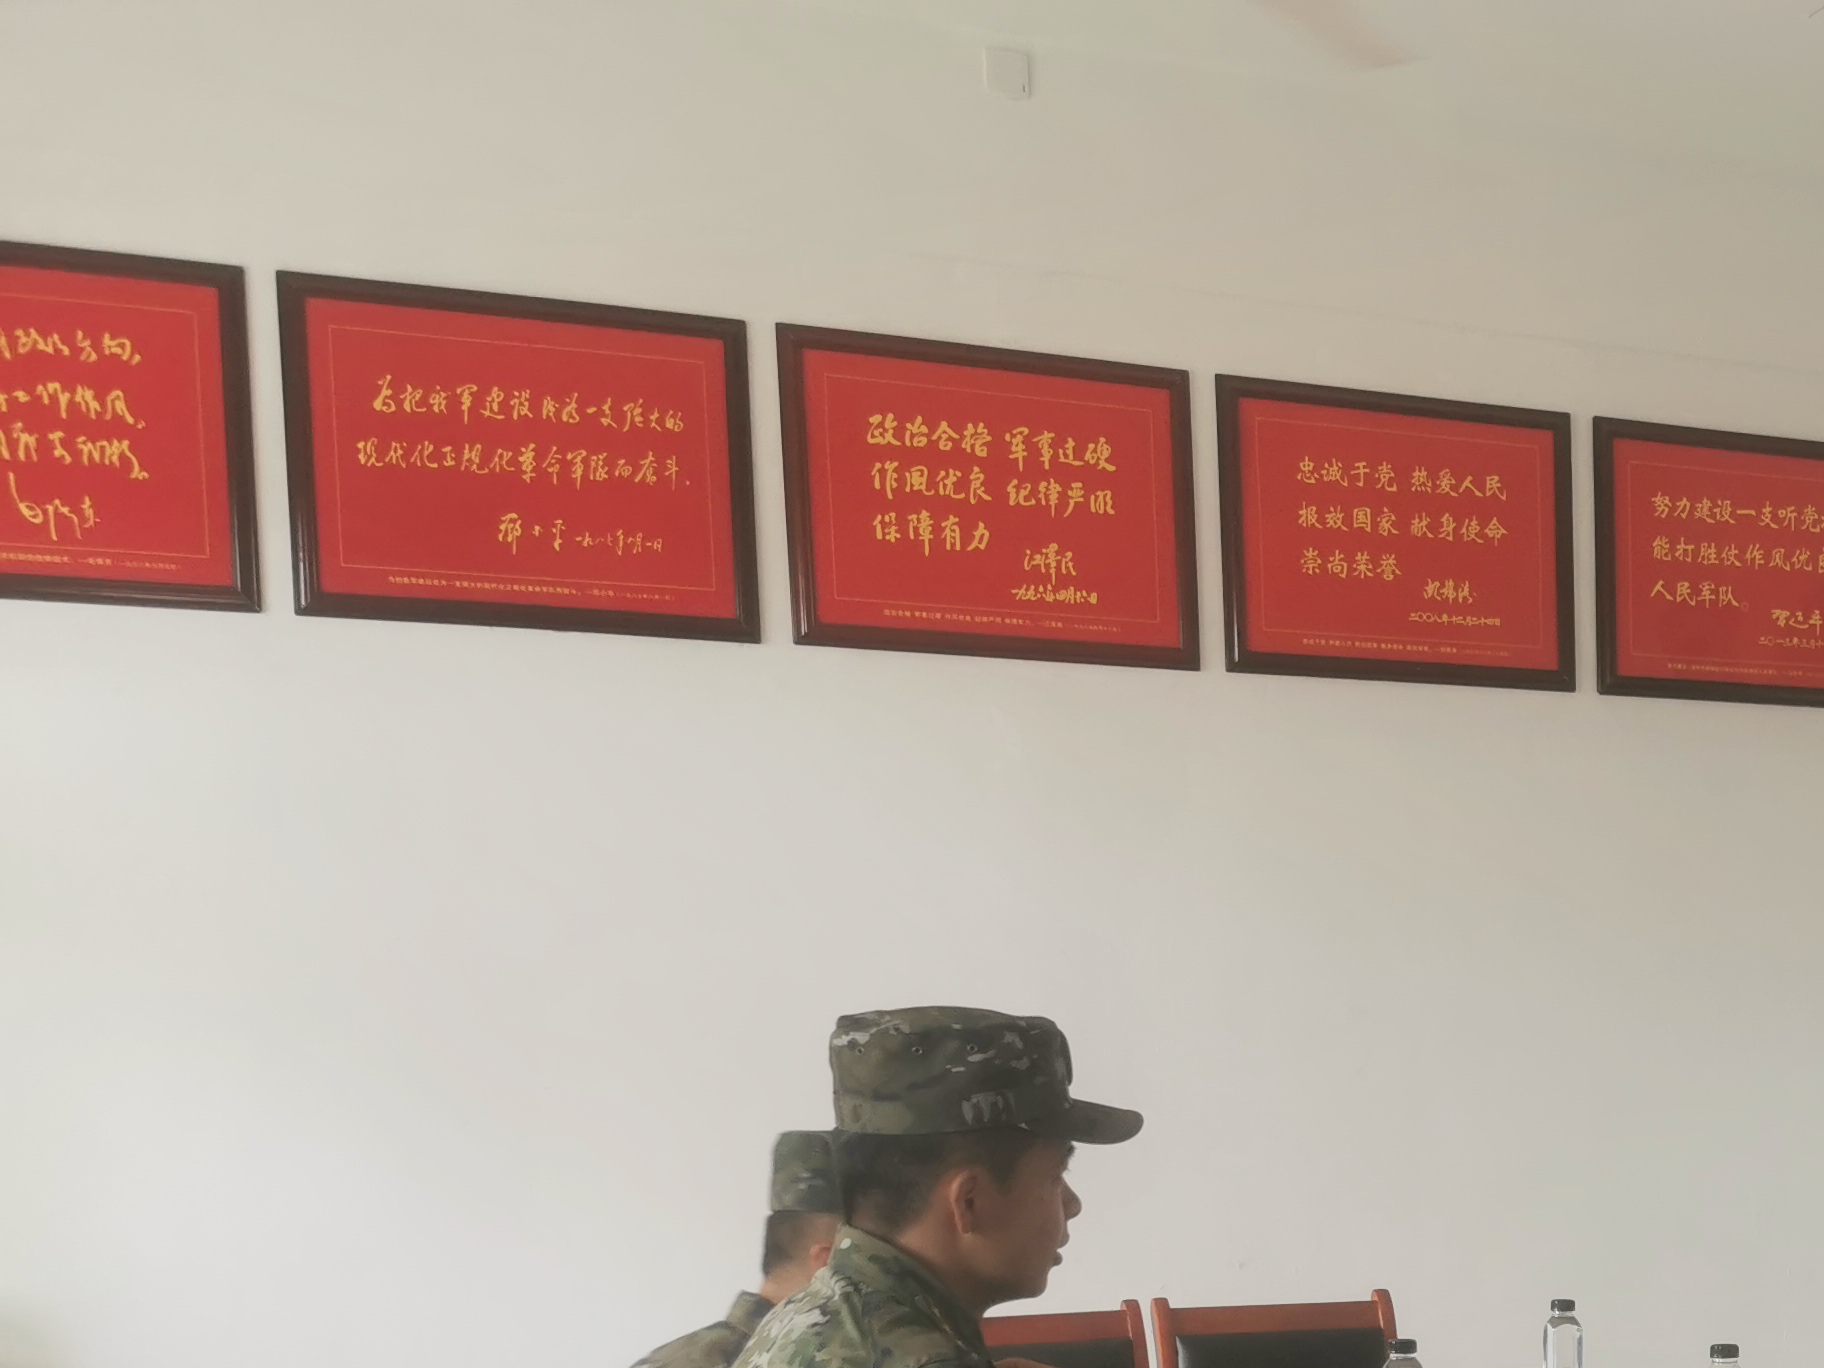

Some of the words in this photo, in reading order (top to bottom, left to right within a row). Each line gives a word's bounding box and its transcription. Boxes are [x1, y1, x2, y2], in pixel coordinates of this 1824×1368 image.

[867, 412, 993, 457] 政治合格
[1004, 427, 1117, 472] 军事过硬
[871, 461, 993, 505] 作风优良
[1006, 477, 1116, 518] 纪律严明
[1296, 455, 1398, 492] 忠诚于党
[1410, 465, 1507, 501] 热爱人民
[872, 509, 990, 557] 保障有力
[1297, 501, 1400, 537] 报效国家
[1410, 512, 1509, 547] 献身使命
[1300, 546, 1403, 581] 崇尚荣誉
